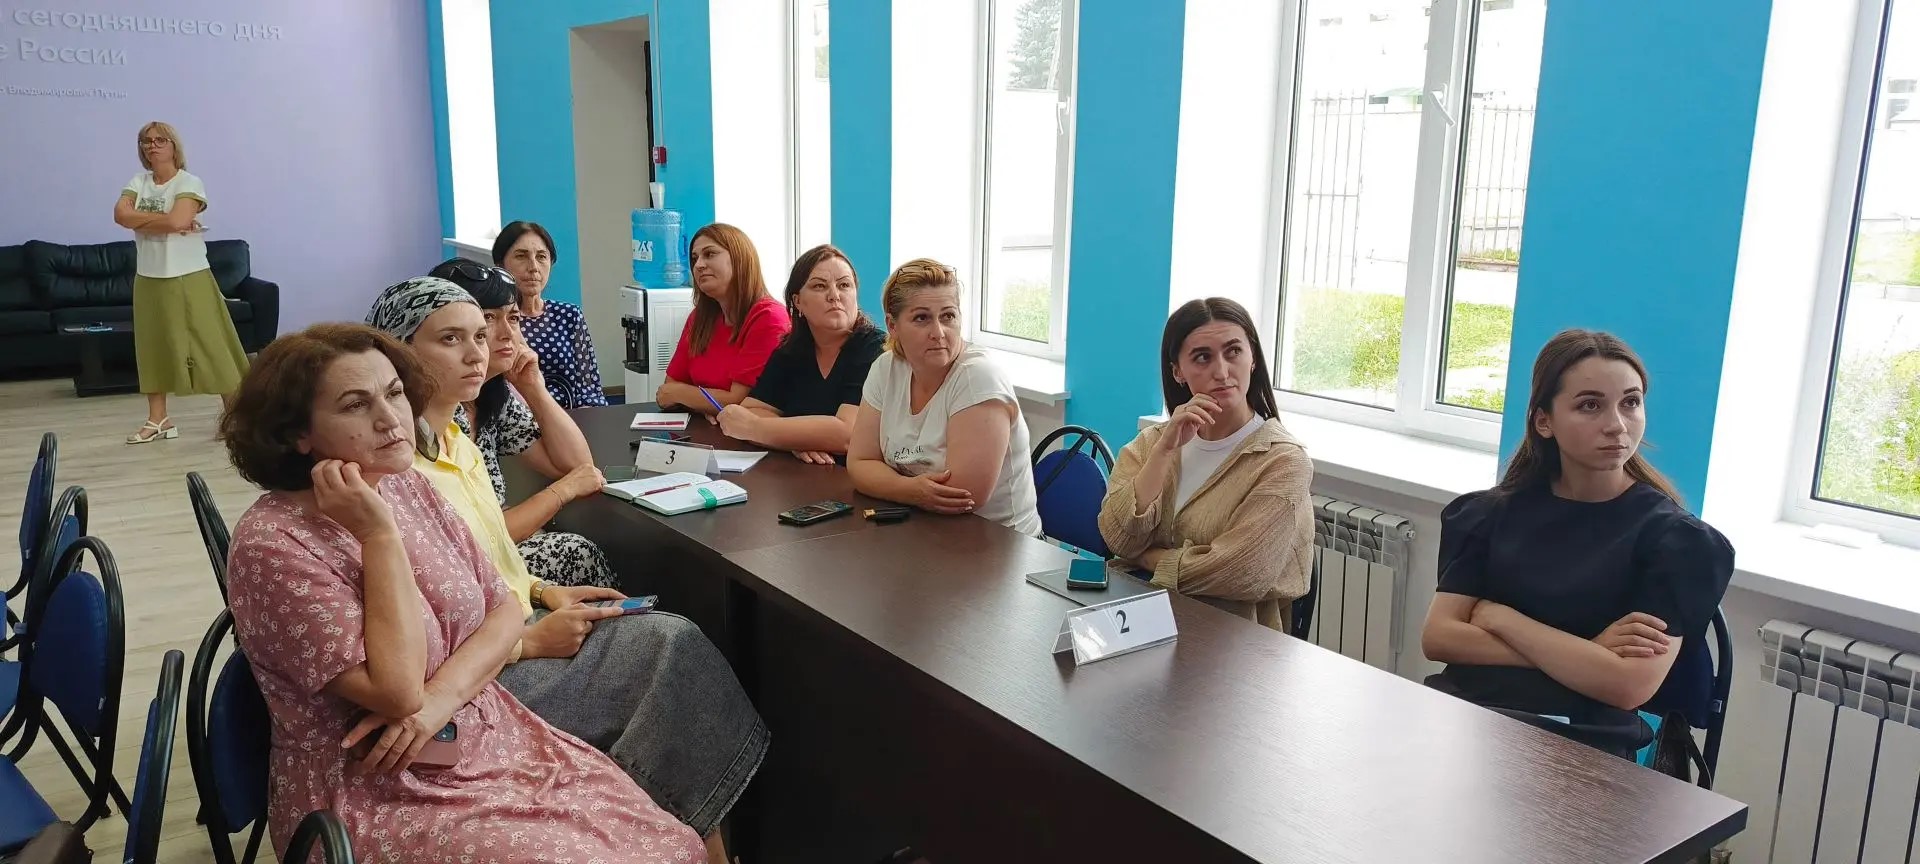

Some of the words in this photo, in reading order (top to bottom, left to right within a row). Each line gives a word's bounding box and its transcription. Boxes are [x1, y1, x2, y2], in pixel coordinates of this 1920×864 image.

[13, 8, 226, 37] сегодняшнего
[233, 21, 283, 41] дня
[18, 37, 128, 66] России
[666, 450, 676, 464] 3
[1116, 610, 1130, 633] 2
